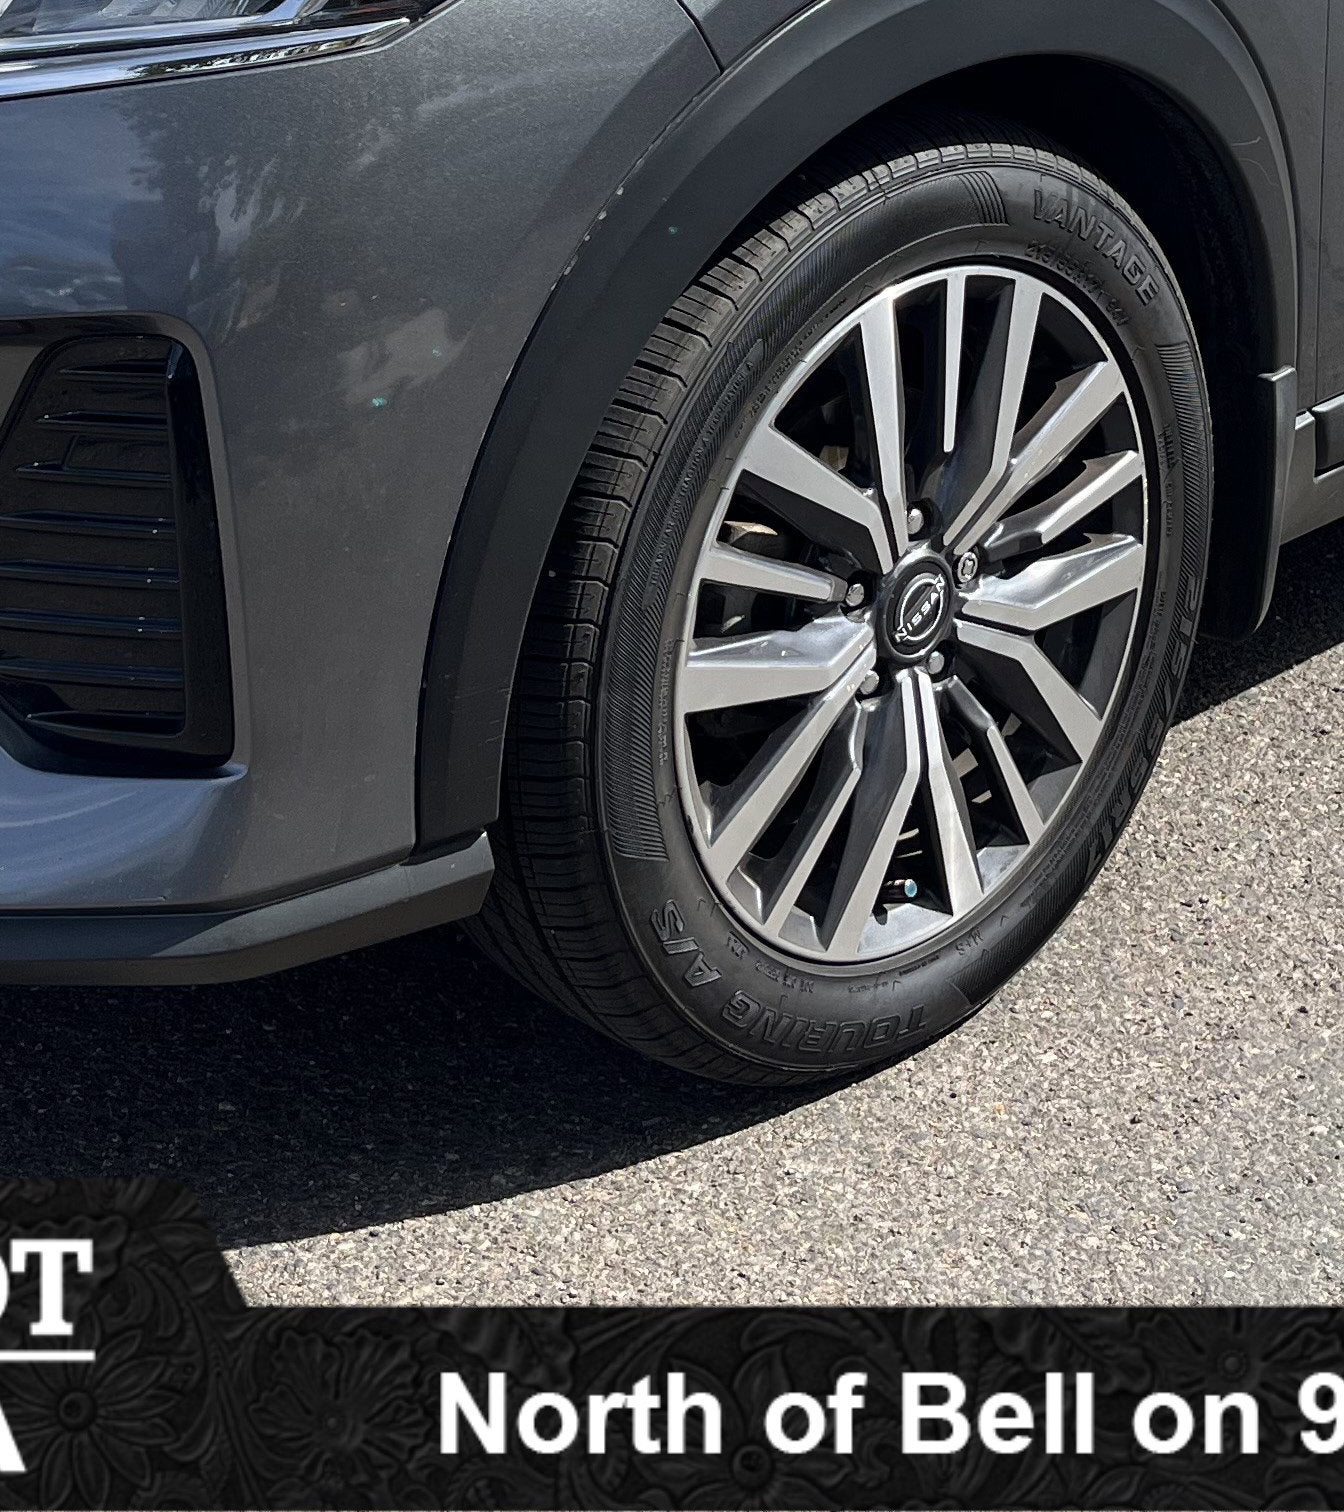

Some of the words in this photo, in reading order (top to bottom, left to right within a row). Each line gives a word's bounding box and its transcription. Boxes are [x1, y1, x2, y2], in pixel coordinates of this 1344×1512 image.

[1034, 188, 1159, 306] VANTAGE
[895, 574, 945, 643] NISSAN
[650, 898, 723, 988] A/S
[721, 990, 928, 1052] TOURING
